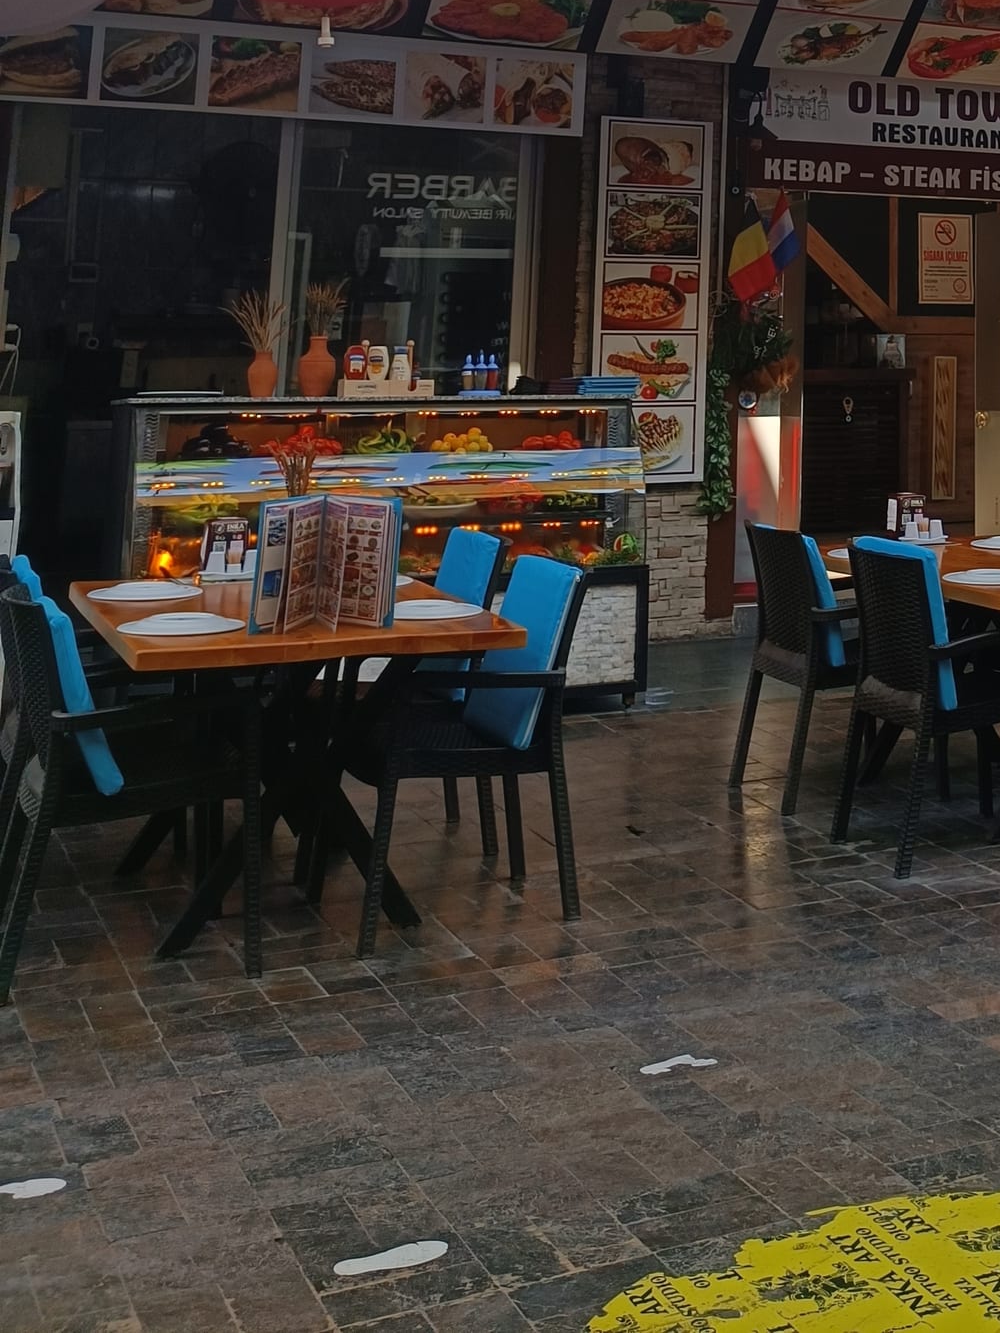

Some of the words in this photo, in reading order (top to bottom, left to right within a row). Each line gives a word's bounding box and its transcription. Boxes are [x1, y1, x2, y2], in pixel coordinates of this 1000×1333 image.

[848, 81, 920, 118] OLD
[764, 158, 851, 184] KEBAP
[884, 165, 961, 189] STEAK
[826, 1235, 880, 1263] ART
[856, 1227, 909, 1265] STUDIO
[650, 1274, 701, 1317] STUDIO
[878, 1270, 943, 1317] INKA
[904, 1266, 962, 1311] TATTOO
